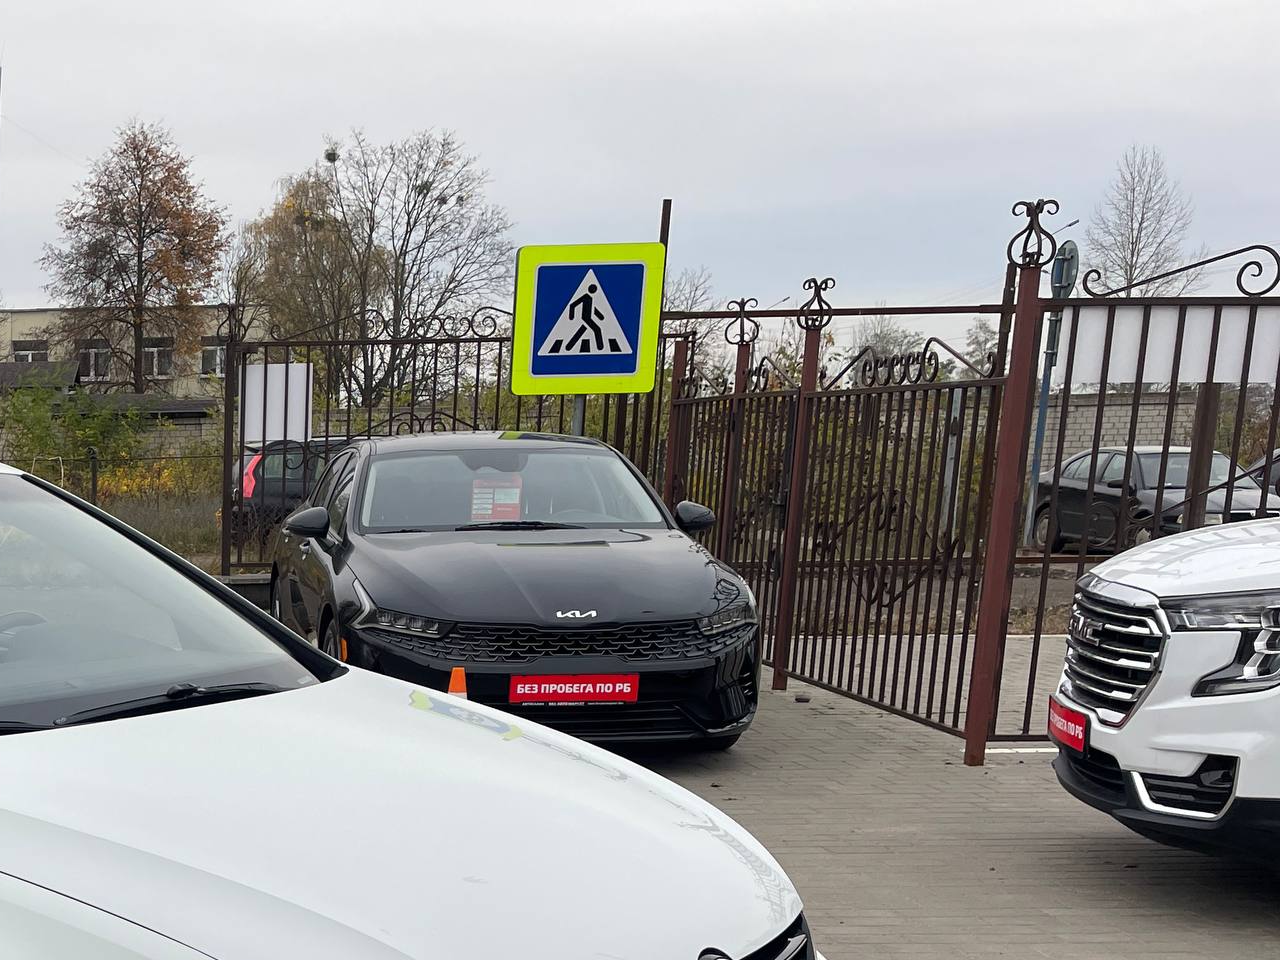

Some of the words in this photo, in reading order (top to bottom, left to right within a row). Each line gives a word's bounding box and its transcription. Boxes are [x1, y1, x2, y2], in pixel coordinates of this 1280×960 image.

[516, 684, 538, 694] БЕЗ
[541, 683, 594, 694] ПРОБЕГА
[595, 683, 613, 693] ПО
[615, 683, 631, 693] РБ
